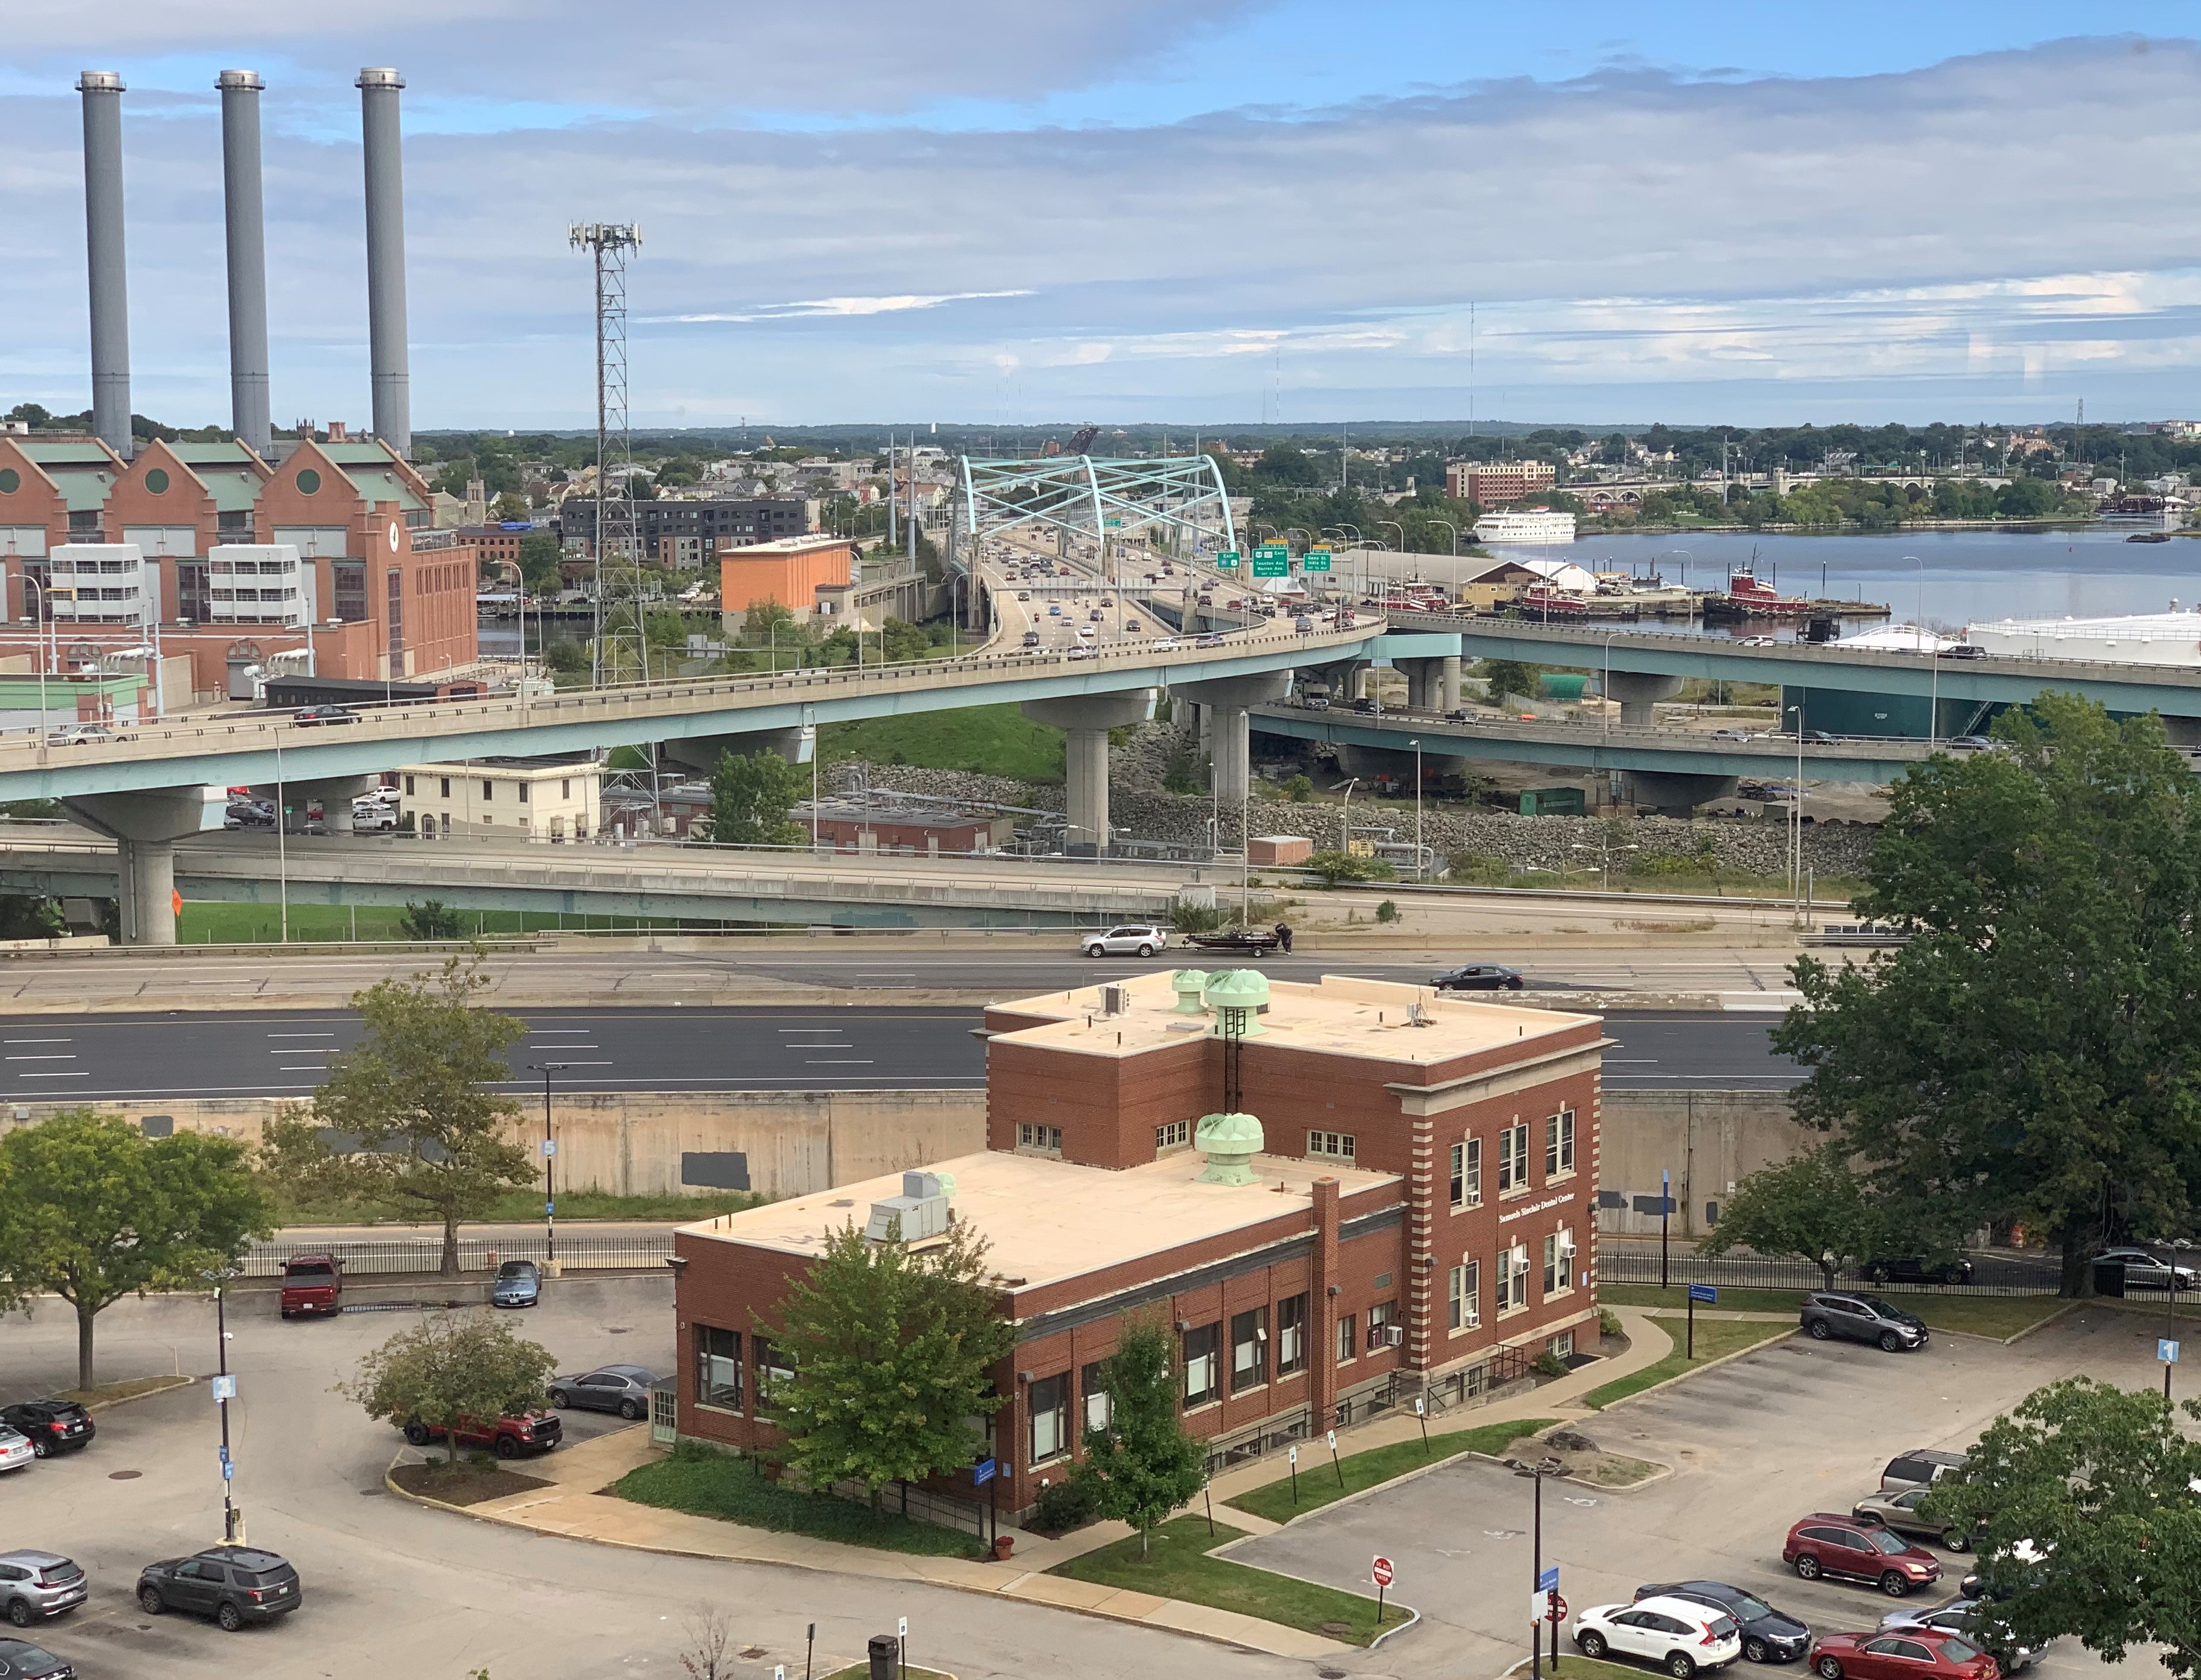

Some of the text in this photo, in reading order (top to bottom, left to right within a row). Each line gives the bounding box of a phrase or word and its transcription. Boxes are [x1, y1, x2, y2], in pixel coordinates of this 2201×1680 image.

[544, 1141, 555, 1155] 5
[1499, 1193, 1575, 1223] Samuels Sinclair Dental Center
[2164, 1342, 2174, 1360] 1
[218, 1378, 232, 1397] 3
[1377, 1574, 1388, 1582] ENTER
